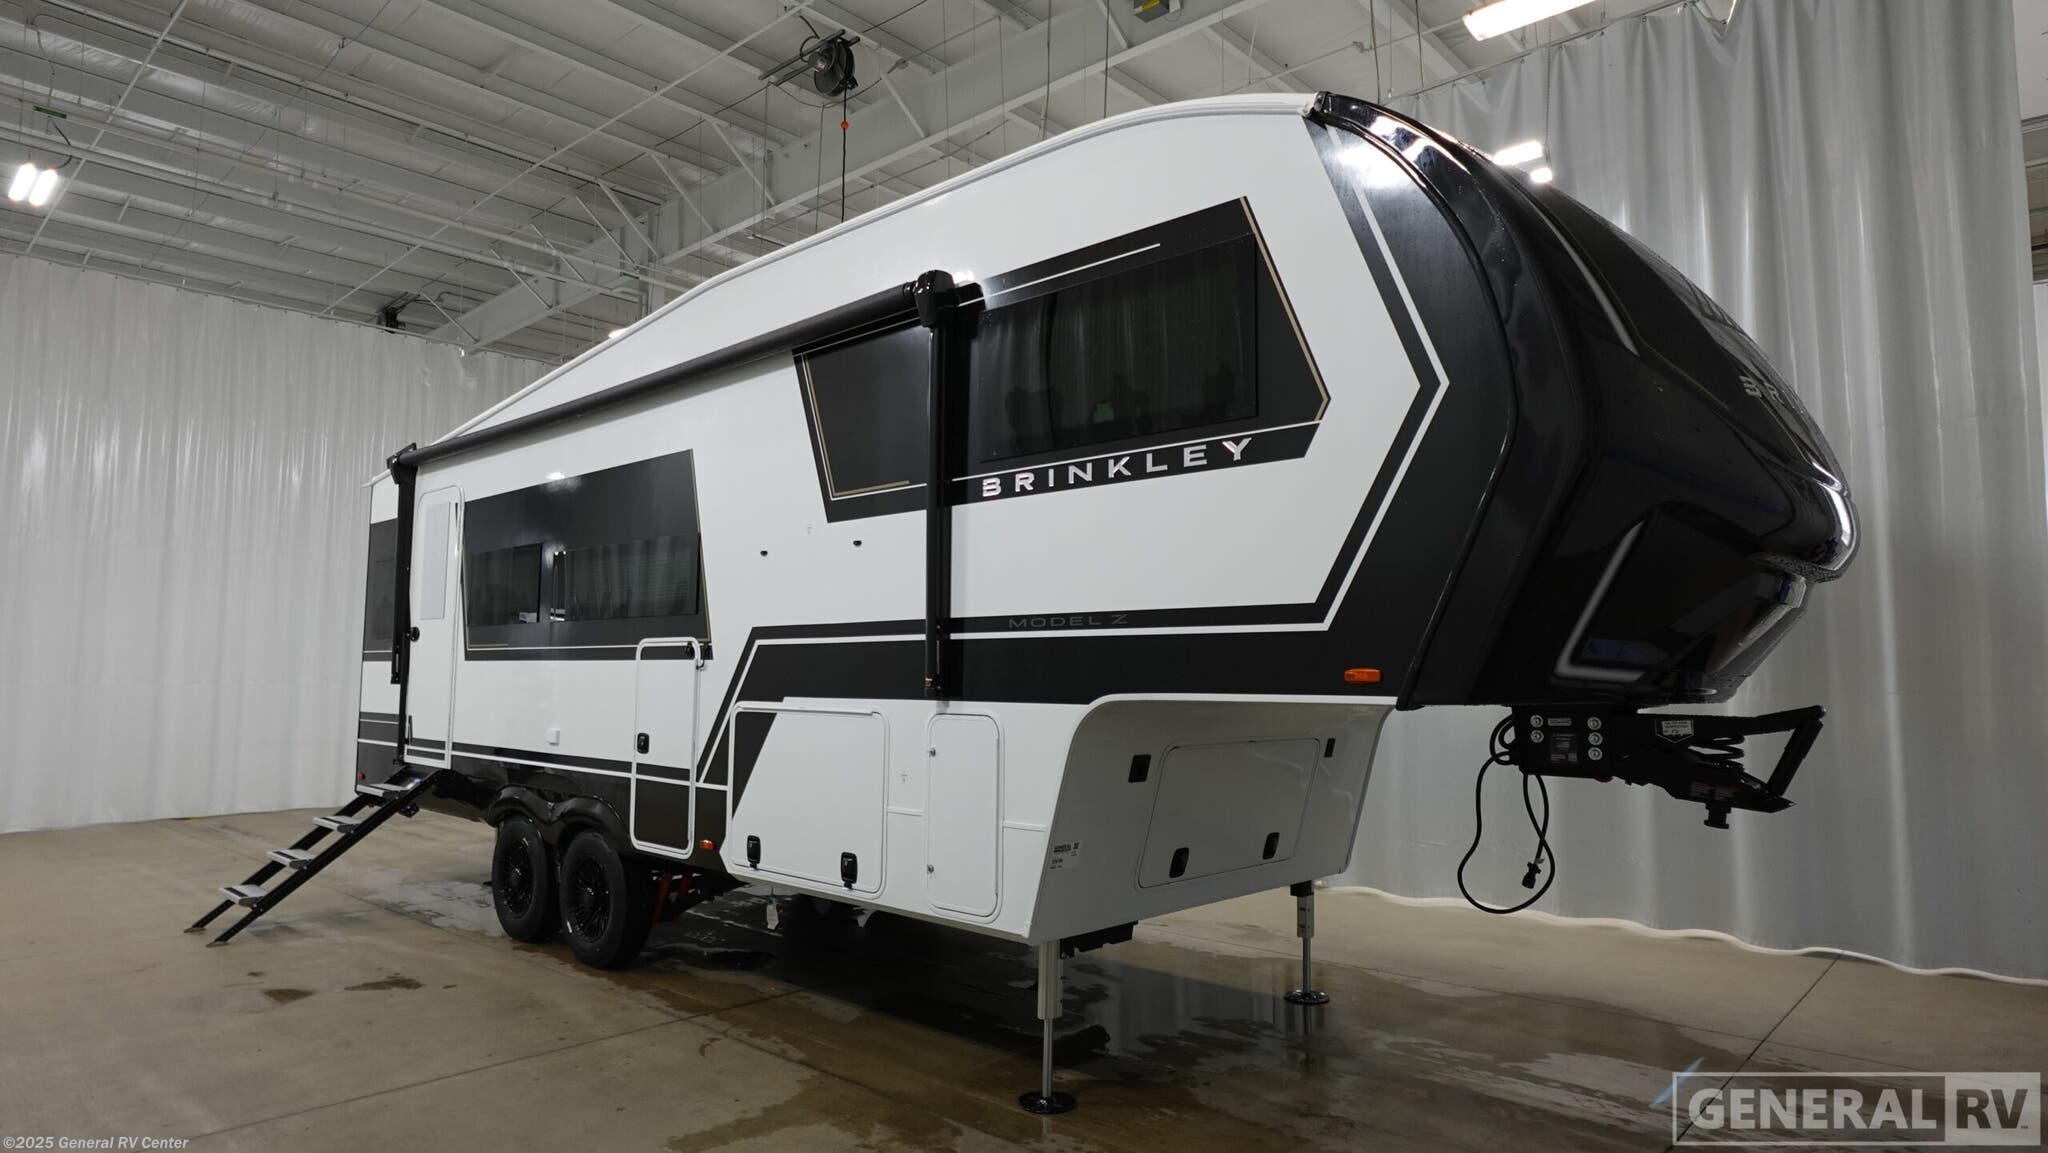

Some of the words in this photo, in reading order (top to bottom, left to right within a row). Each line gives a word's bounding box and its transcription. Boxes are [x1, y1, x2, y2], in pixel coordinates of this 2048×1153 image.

[982, 438, 1252, 497] BRINKLEY
[1008, 614, 1103, 629] MODEL
[1111, 614, 1128, 625] Z
